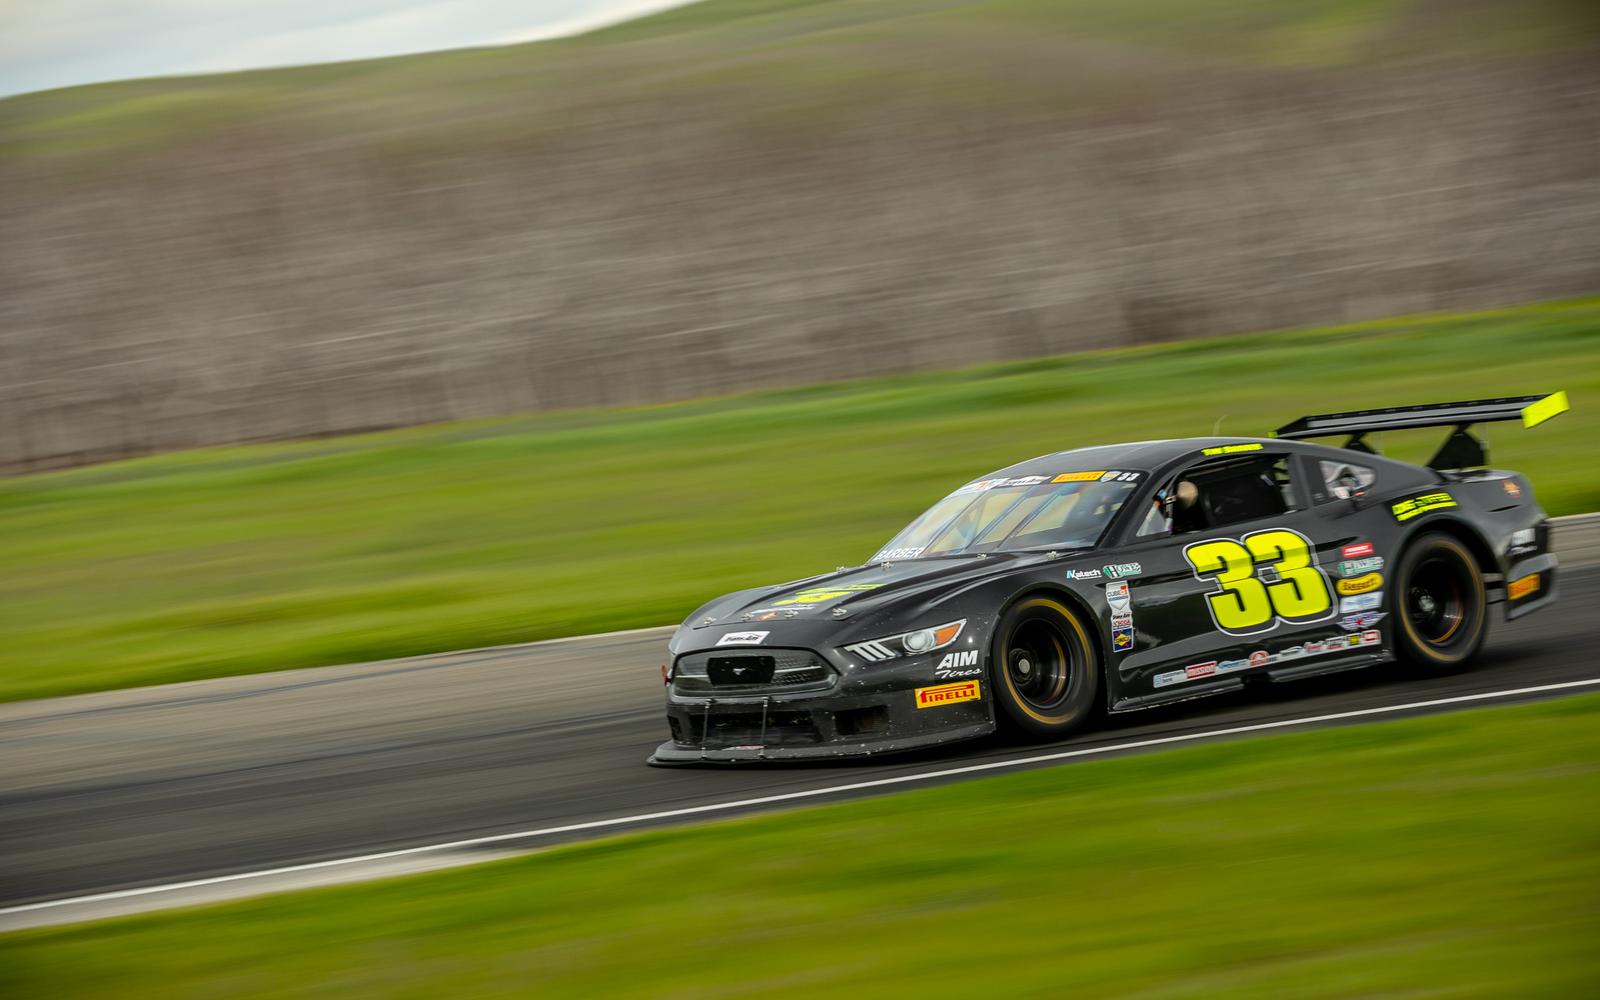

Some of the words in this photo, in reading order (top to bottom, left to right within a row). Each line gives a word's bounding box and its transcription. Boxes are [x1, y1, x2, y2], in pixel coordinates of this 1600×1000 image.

[1116, 472, 1141, 482] 33
[1183, 529, 1336, 633] 33
[936, 650, 979, 670] AIM
[935, 668, 983, 679] Tires
[920, 684, 976, 703] PIRELLI
